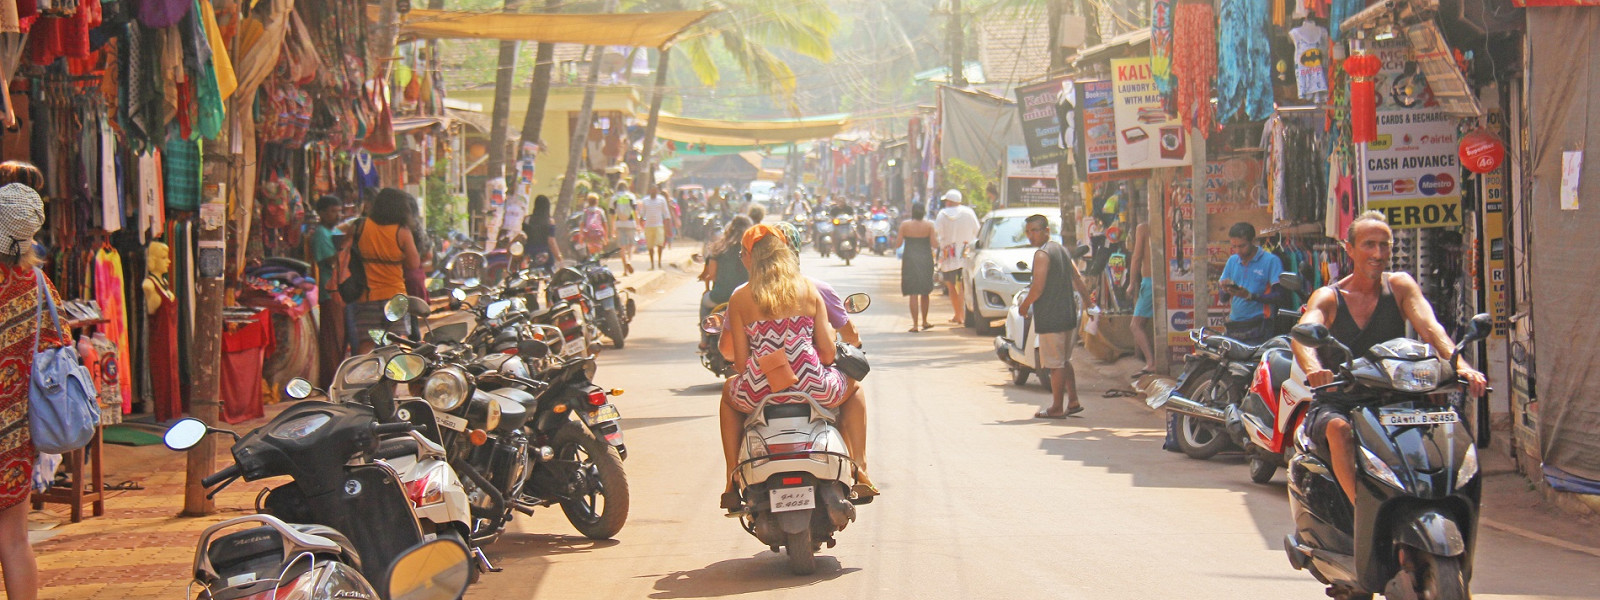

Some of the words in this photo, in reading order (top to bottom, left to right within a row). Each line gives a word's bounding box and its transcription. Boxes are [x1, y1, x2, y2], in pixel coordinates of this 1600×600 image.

[1118, 83, 1149, 93] LAUNDRY
[1124, 96, 1143, 105] WITH
[1381, 114, 1403, 125] CARDS
[1405, 113, 1410, 123] &
[1430, 134, 1453, 144] airtel
[1368, 159, 1398, 170] CASH
[1402, 155, 1455, 168] ADVANCE
[1478, 157, 1493, 167] 4G
[1421, 180, 1451, 189] Maestro
[1391, 416, 1402, 424] GA
